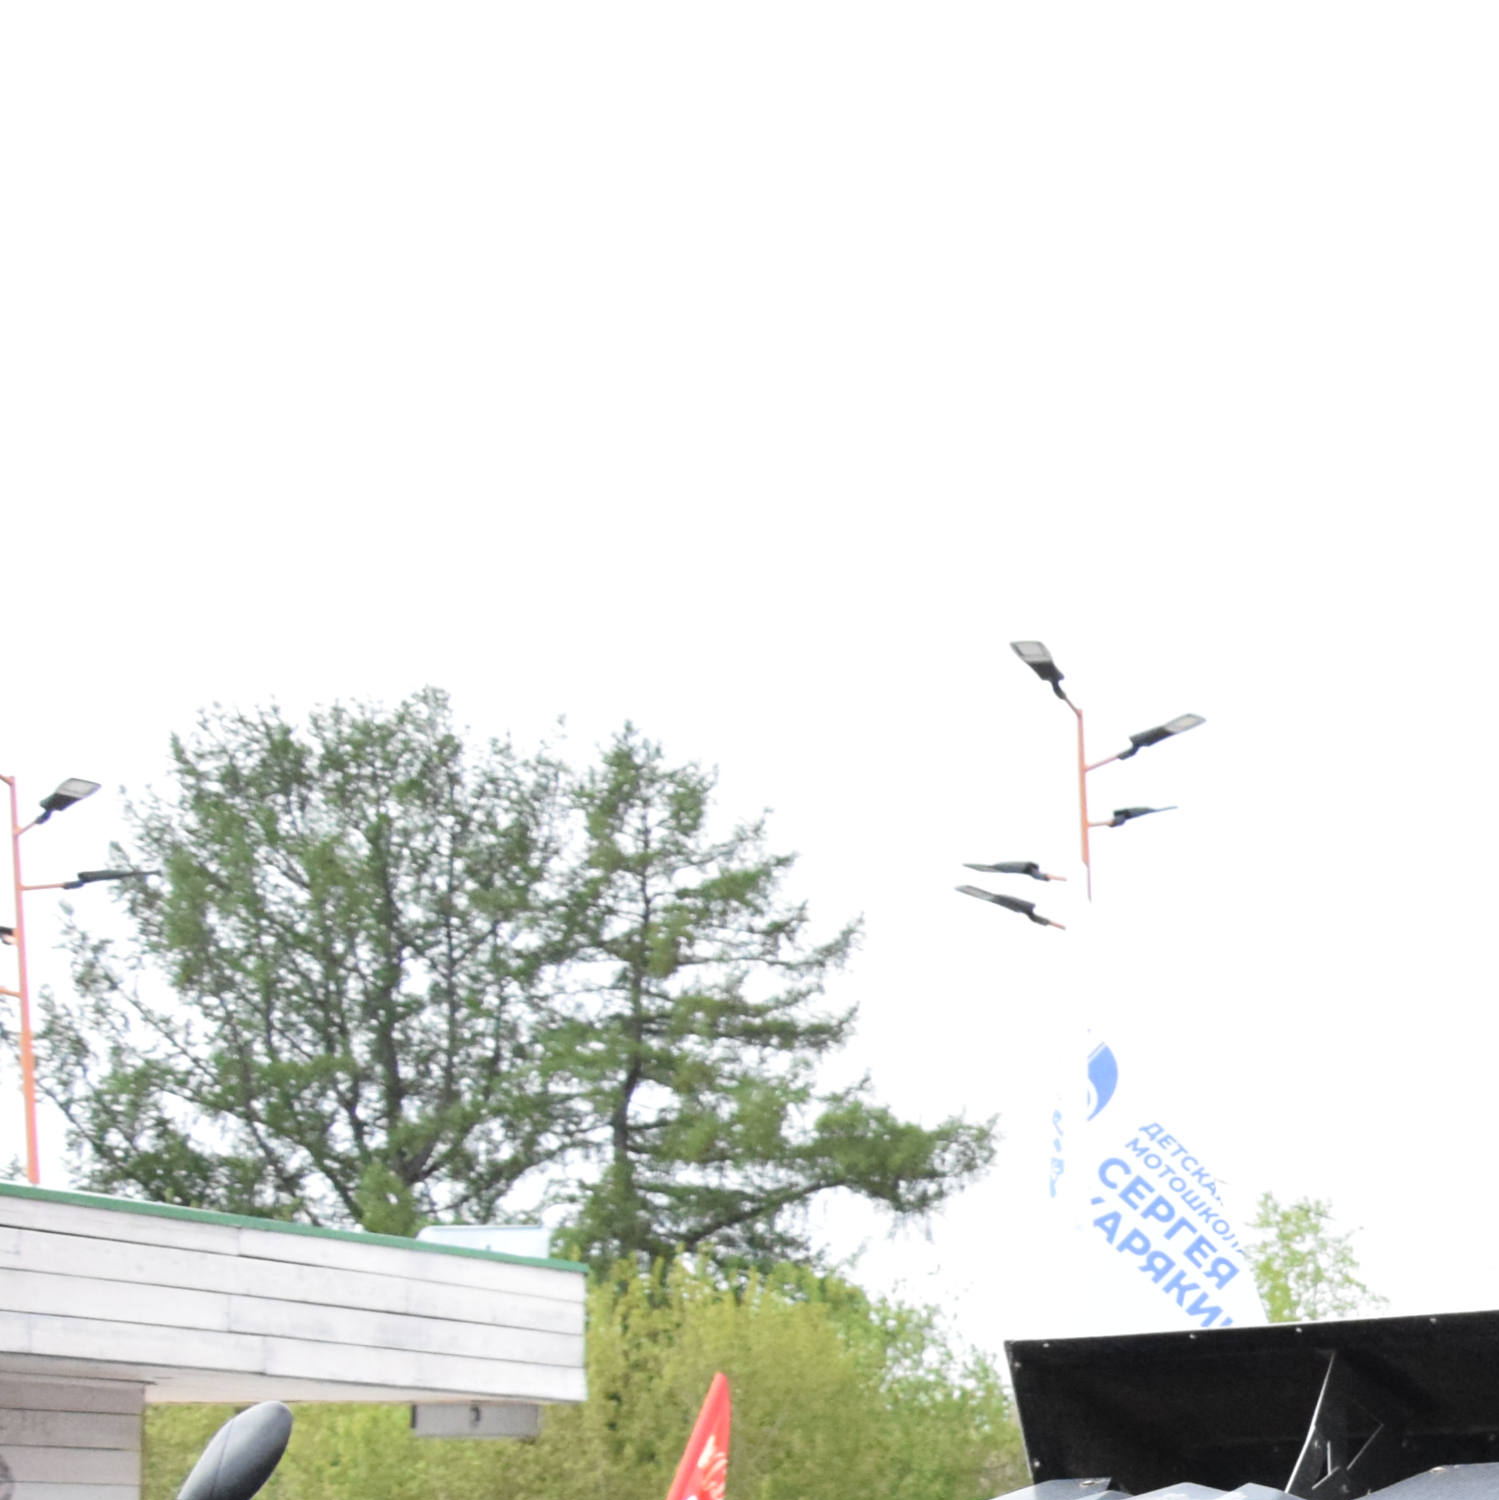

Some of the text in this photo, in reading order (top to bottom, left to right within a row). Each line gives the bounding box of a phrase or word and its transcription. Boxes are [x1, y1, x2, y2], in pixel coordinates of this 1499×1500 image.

[1098, 1157, 1240, 1290] СЕРГЕЯ
[1125, 1137, 1243, 1254] МОТОШКОЛ
[1138, 1121, 1224, 1207] ДЕТСКА
[1090, 1196, 1234, 1328] АРЯКИ
